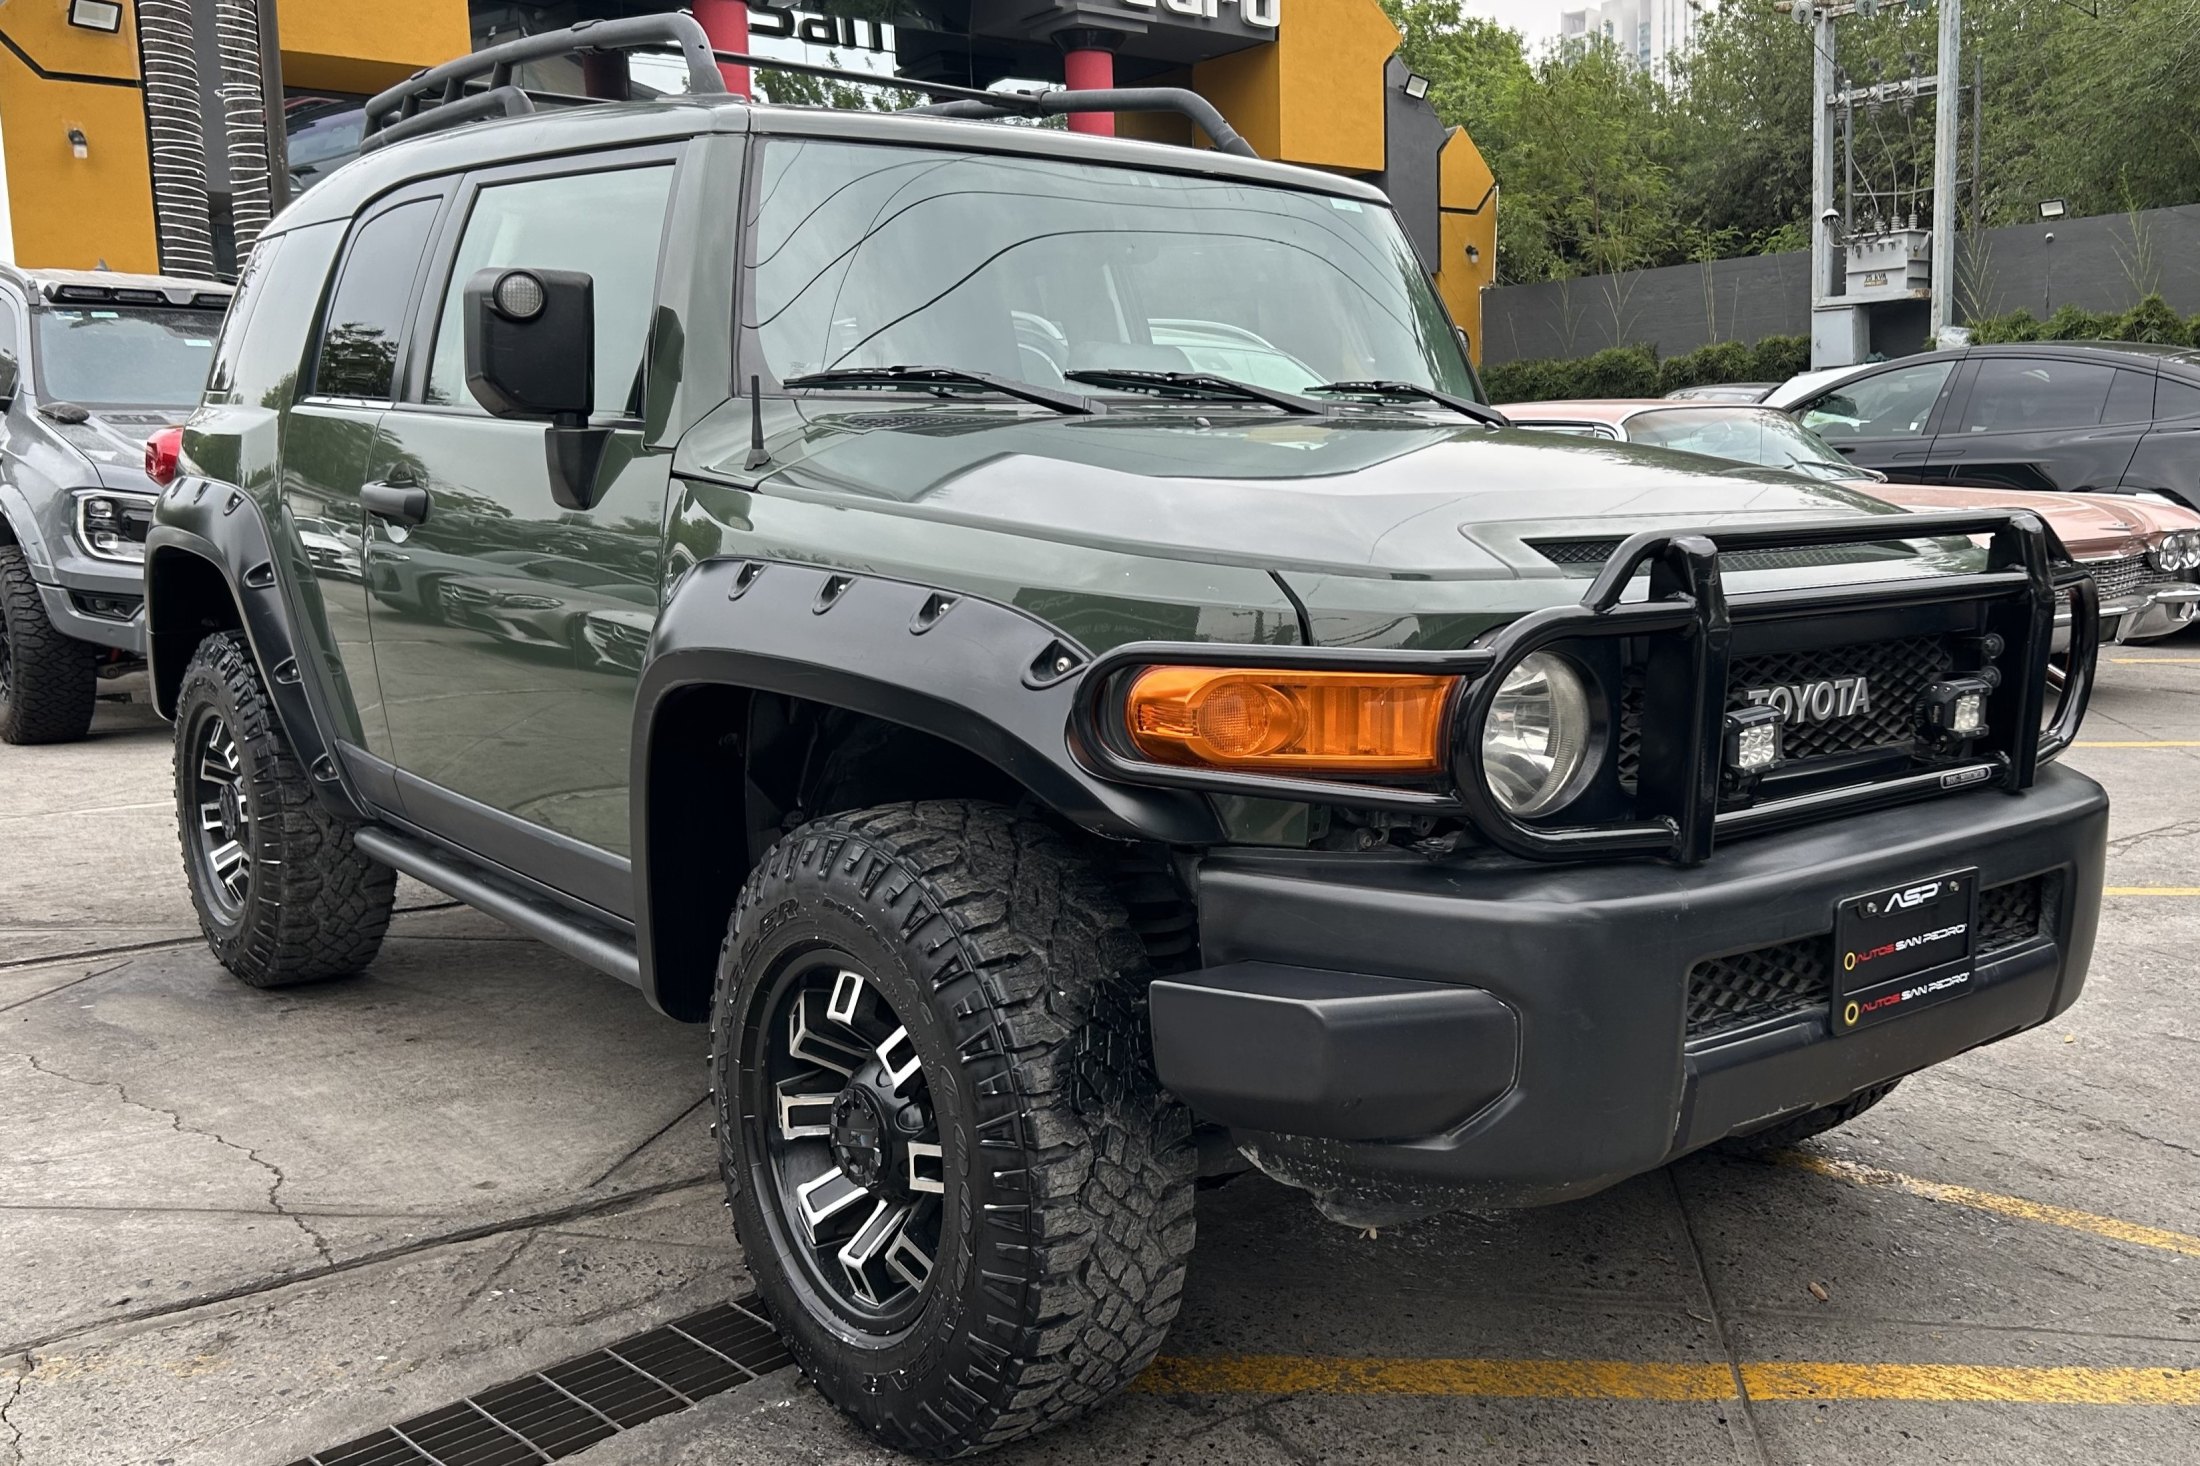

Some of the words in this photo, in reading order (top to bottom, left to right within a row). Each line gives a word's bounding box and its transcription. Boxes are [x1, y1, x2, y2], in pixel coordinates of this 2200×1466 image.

[1748, 677, 1870, 723] TOYOTA
[1884, 882, 1939, 912] ASP
[1856, 944, 1895, 963] AUTOS
[1895, 936, 1922, 951] SAN
[1923, 924, 1966, 942] PEDRO
[1861, 993, 1900, 1013] AUTOS
[1901, 985, 1928, 1000] SAN
[1928, 972, 1968, 992] PEDRO
